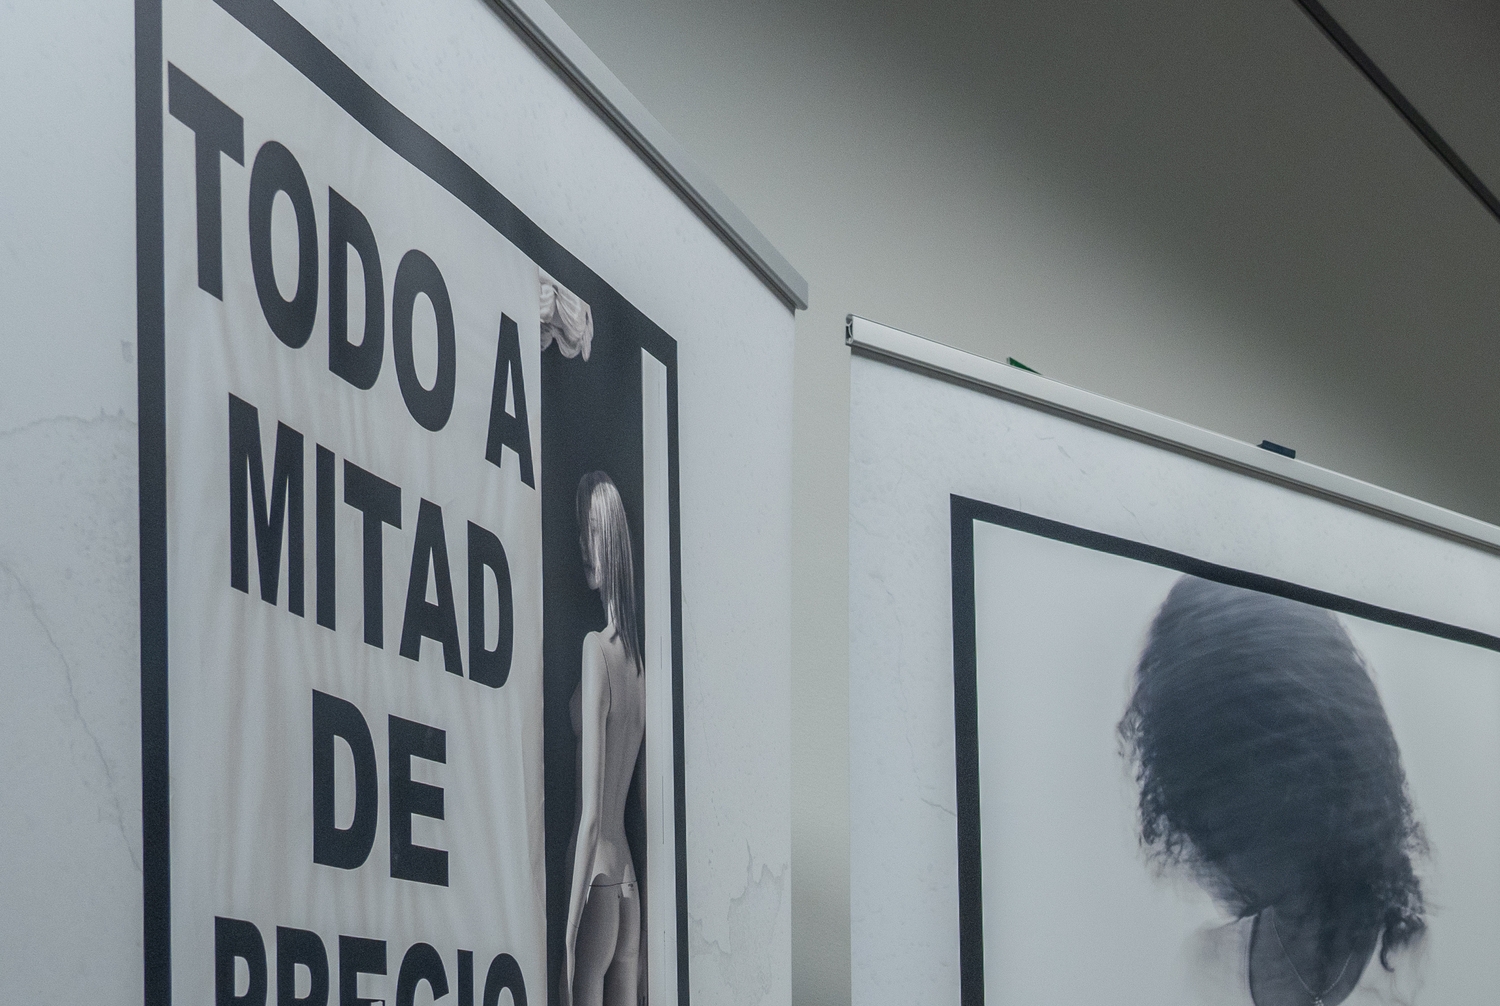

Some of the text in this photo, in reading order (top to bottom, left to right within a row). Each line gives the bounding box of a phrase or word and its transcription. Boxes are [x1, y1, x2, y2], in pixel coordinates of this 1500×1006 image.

[167, 61, 536, 490] TODO A
[228, 392, 514, 689] MITAD
[312, 689, 449, 888] DE
